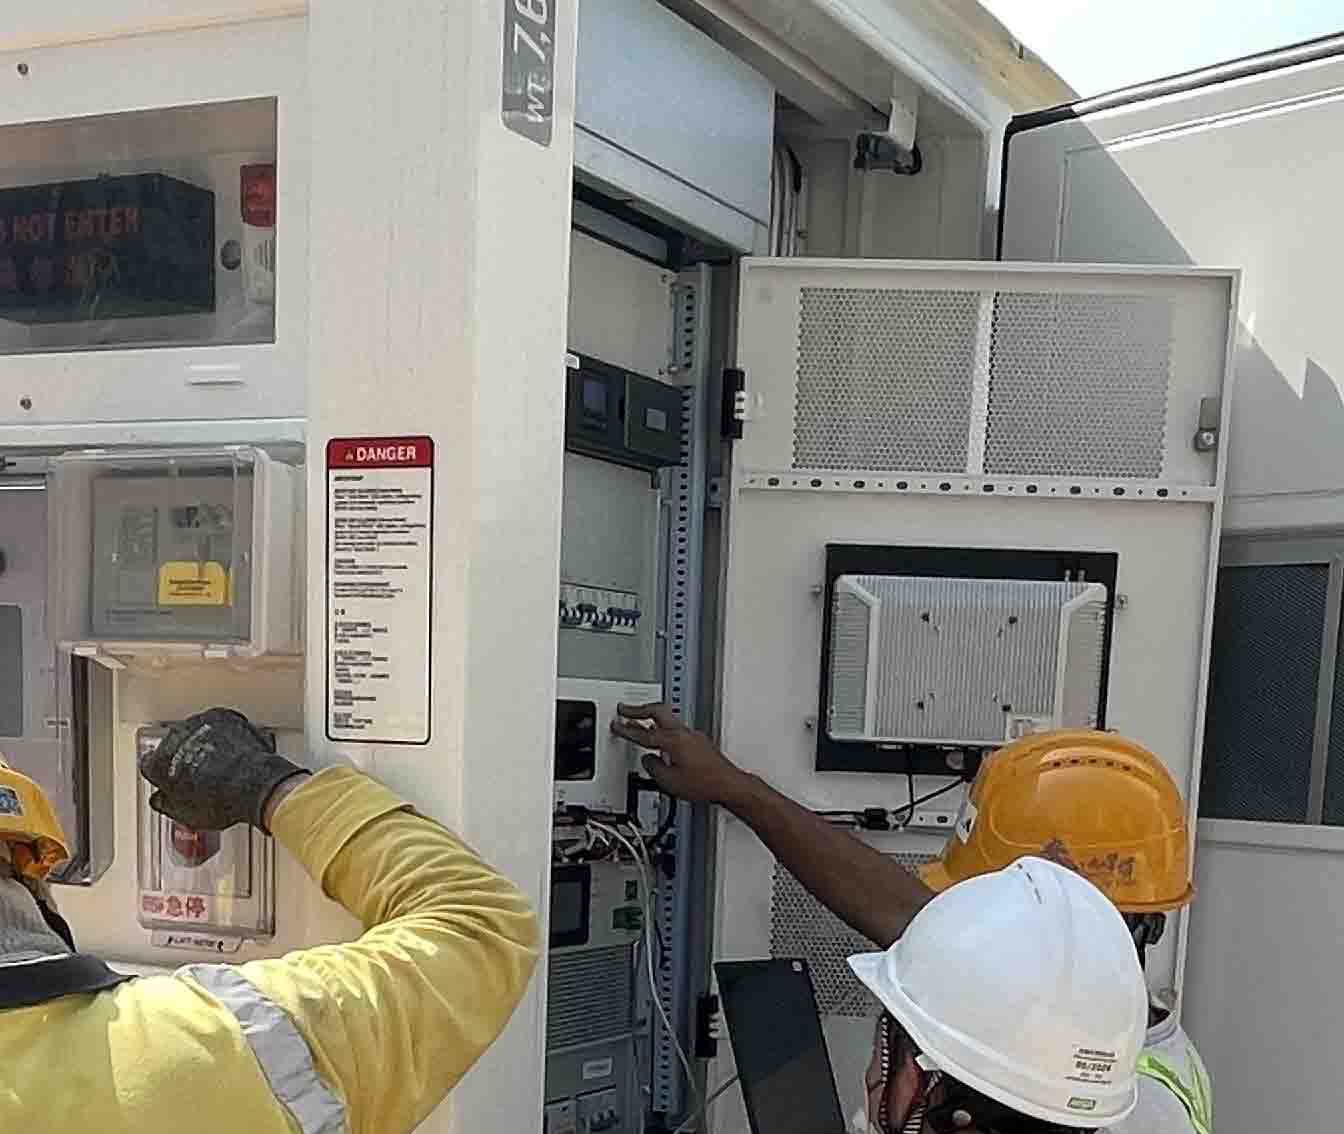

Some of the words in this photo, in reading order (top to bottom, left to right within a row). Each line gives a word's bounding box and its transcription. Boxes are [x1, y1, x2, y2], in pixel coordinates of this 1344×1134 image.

[13, 212, 55, 243] NOT
[64, 206, 139, 239] ENTER
[355, 445, 417, 462] DANGER
